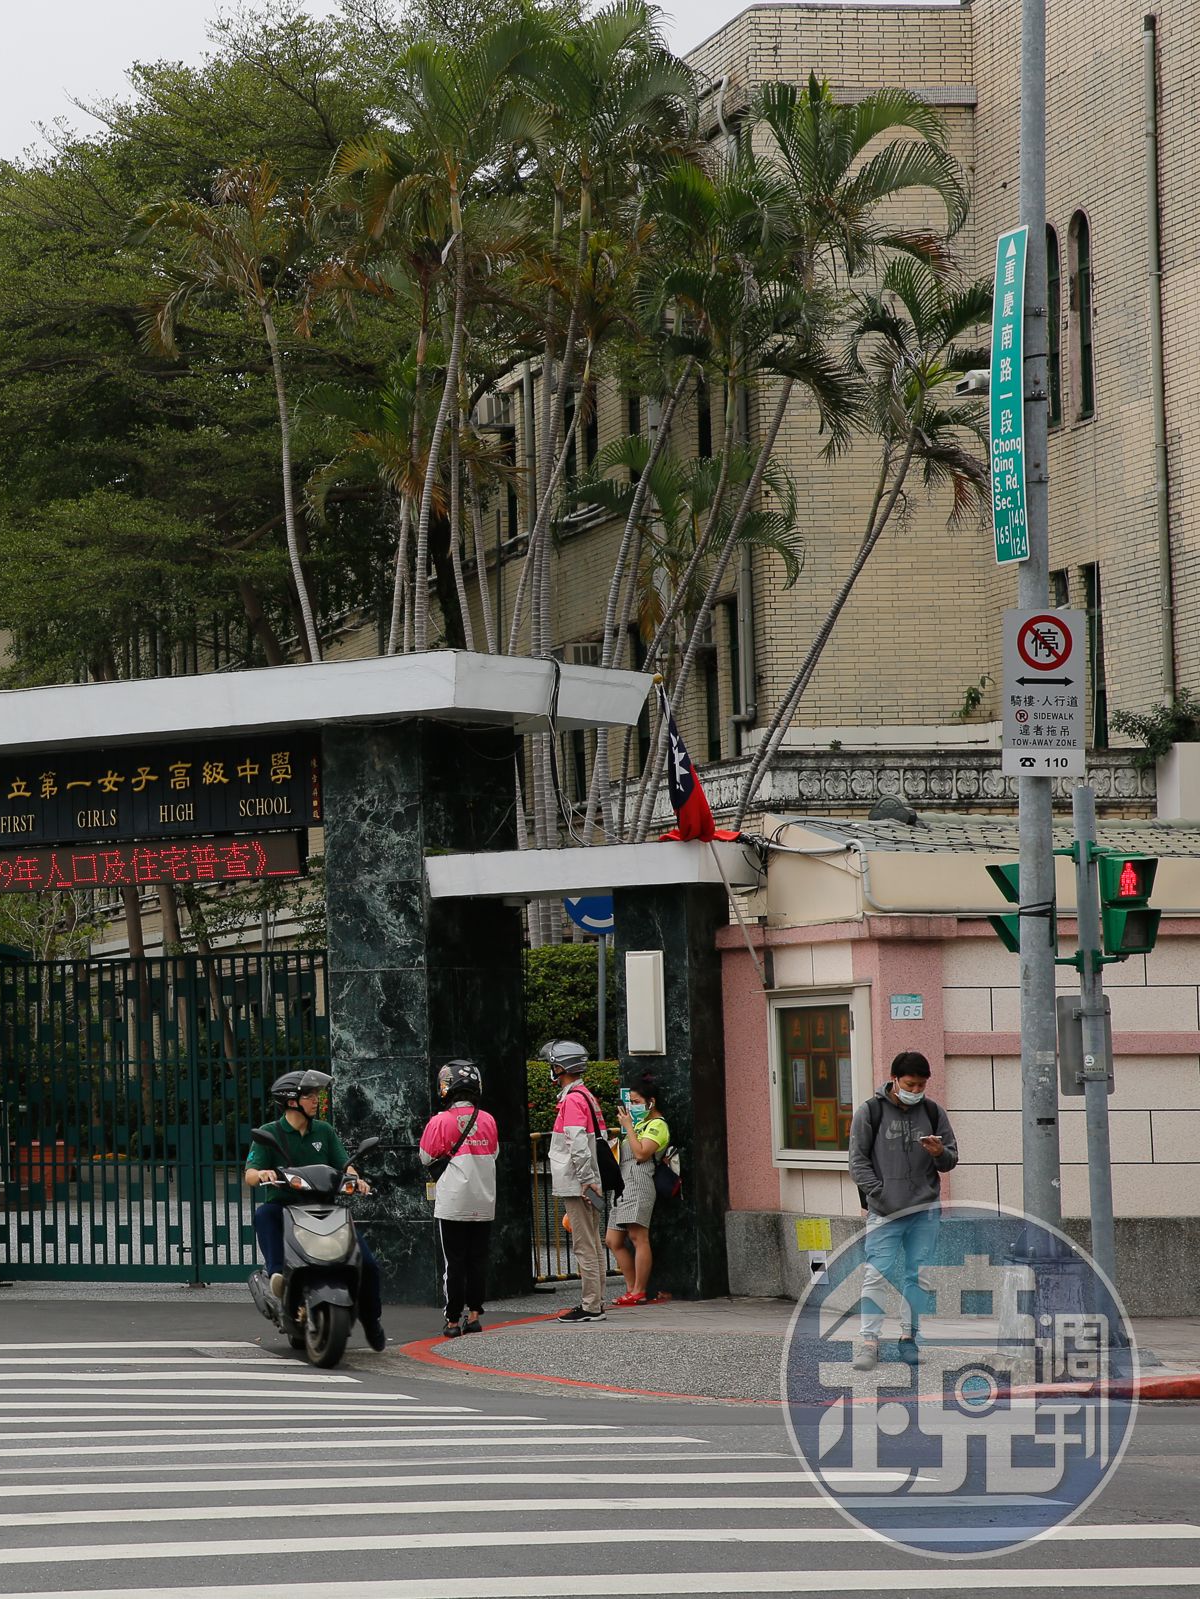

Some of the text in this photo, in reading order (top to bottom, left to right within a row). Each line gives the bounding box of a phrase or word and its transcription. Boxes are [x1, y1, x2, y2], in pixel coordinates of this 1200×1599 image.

[999, 259, 1016, 435] 重慶南路一段
[993, 437, 1022, 455] Chong
[993, 456, 1014, 474] Qing
[994, 473, 1020, 493] S. Rd.
[995, 490, 1021, 511] Sec. 1
[996, 525, 1010, 545] 165
[1033, 712, 1075, 721] SIDEWALK
[1019, 724, 1070, 737] 違者拖吊
[1011, 738, 1078, 748] TOW-AWAY ZONE
[1044, 757, 1069, 768] 110
[0, 814, 35, 834] FIRST
[77, 808, 117, 829] GIRLS
[159, 803, 194, 823] HIGH
[239, 796, 292, 817] SCHOOL
[894, 1005, 921, 1017] 165
